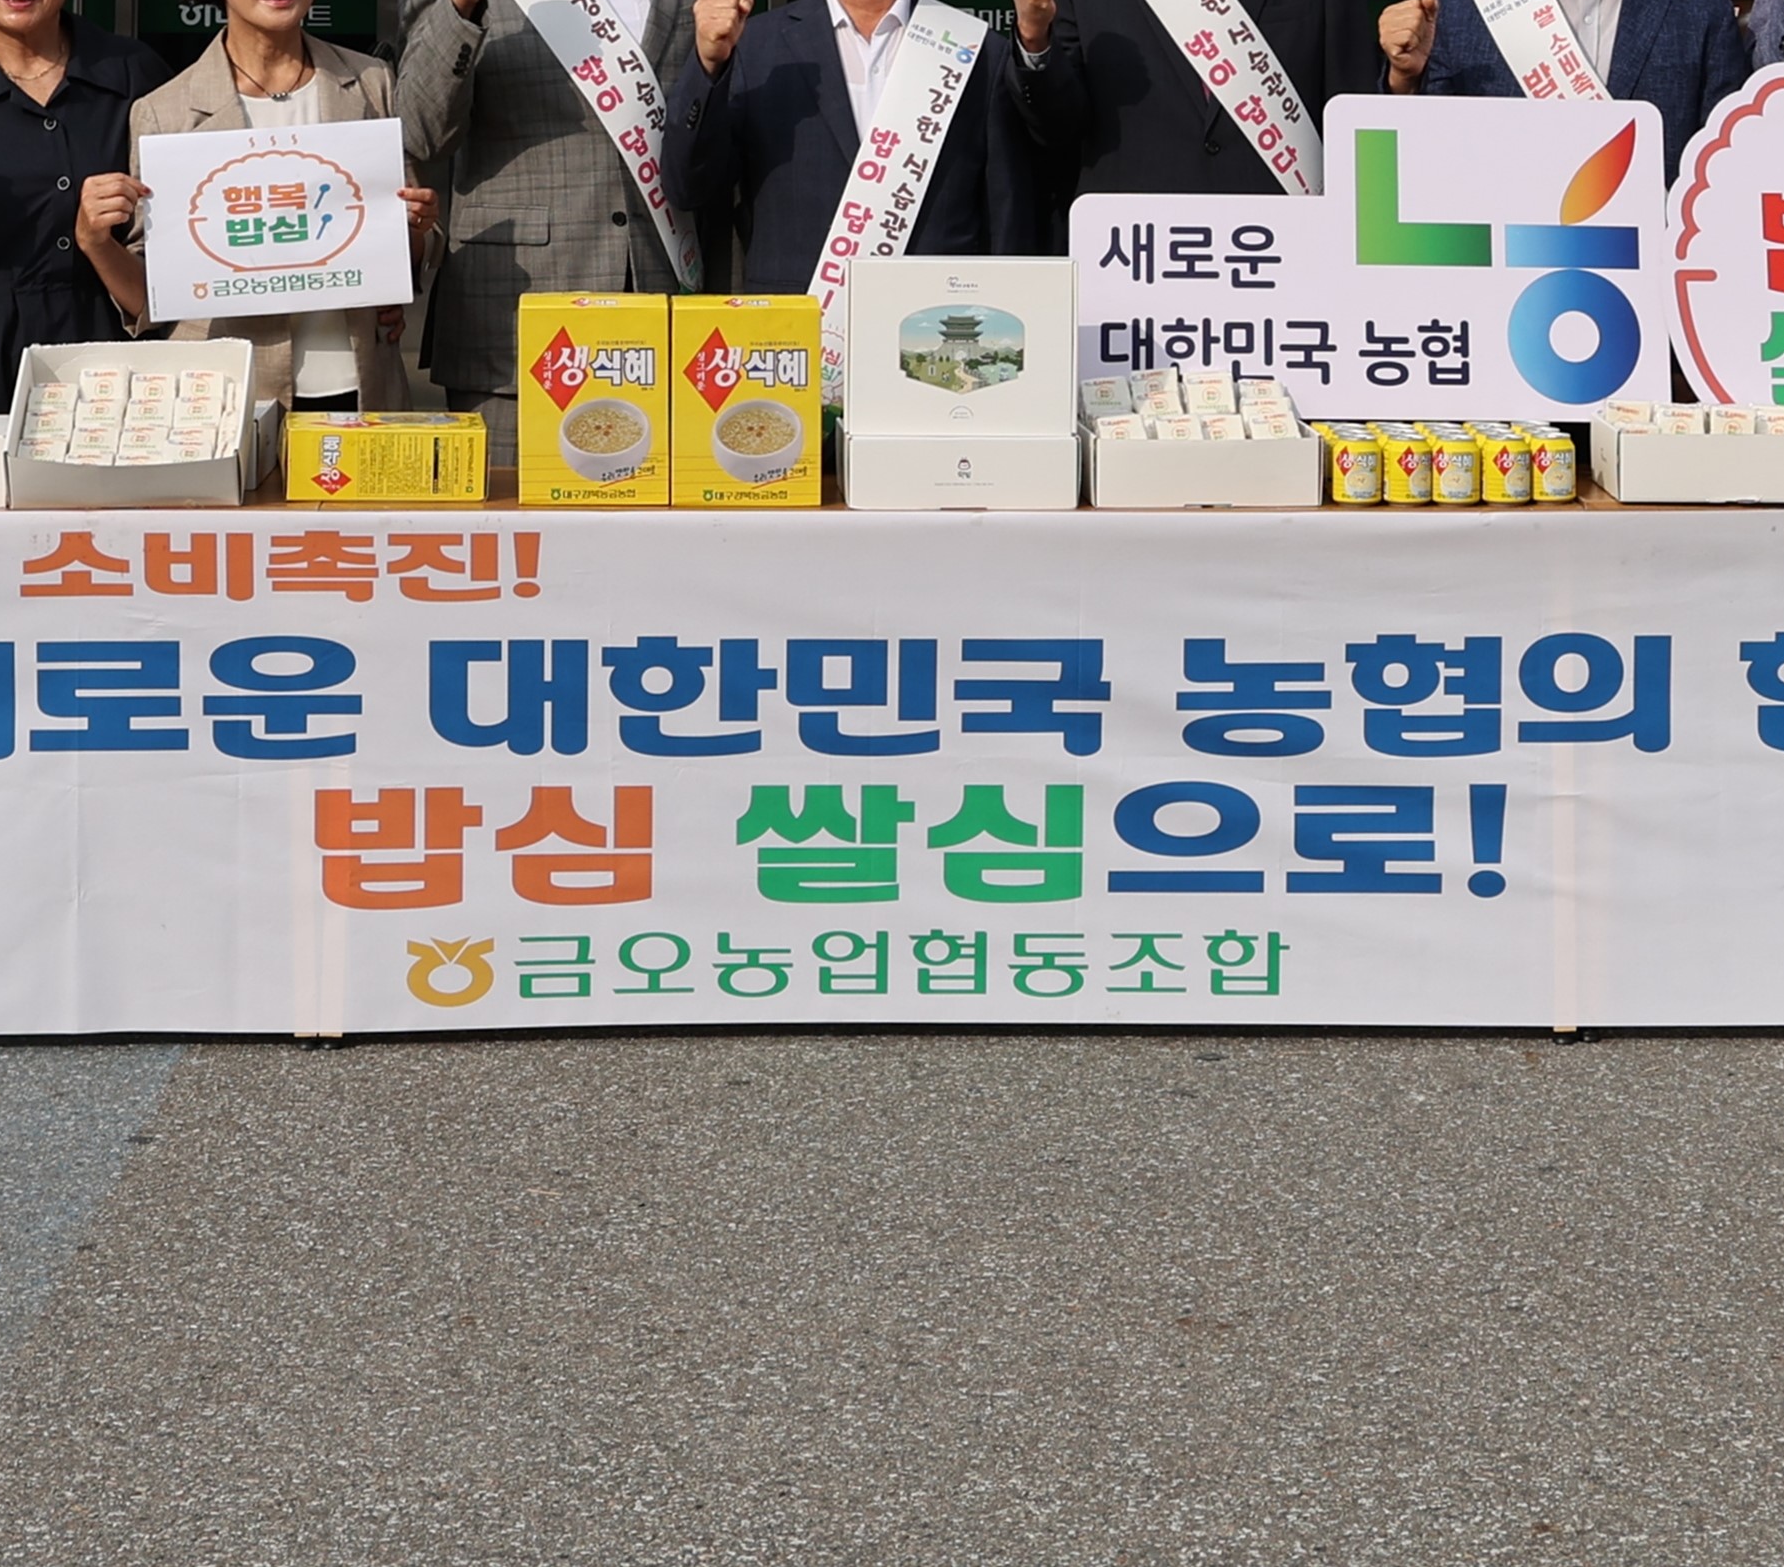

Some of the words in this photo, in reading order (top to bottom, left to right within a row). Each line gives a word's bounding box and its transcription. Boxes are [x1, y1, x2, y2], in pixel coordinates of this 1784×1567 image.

[572, 54, 624, 113] 밥이
[1184, 30, 1237, 86] 밥이
[1532, 4, 1556, 29] 쌀
[1550, 33, 1604, 100] 소비촉
[616, 50, 665, 133] 식습관
[915, 64, 963, 144] 건강한
[857, 127, 901, 184] 밥이
[222, 182, 308, 215] 행복
[225, 213, 309, 247] 밥심
[212, 269, 363, 298] 금오농업협동조합
[1099, 222, 1283, 290] 새로운
[553, 345, 656, 388] 생식혜
[705, 345, 808, 389] 생식혜
[1099, 317, 1338, 387] 대한민국
[1358, 318, 1471, 388] 농협
[20, 530, 545, 603] 소비촉진!
[428, 634, 1112, 759] 대한민국
[1175, 630, 1673, 759] 농협의
[312, 782, 655, 911] 밥심
[735, 780, 1509, 905] 쌀심으로!
[511, 928, 1290, 999] 금오농업협동조합
